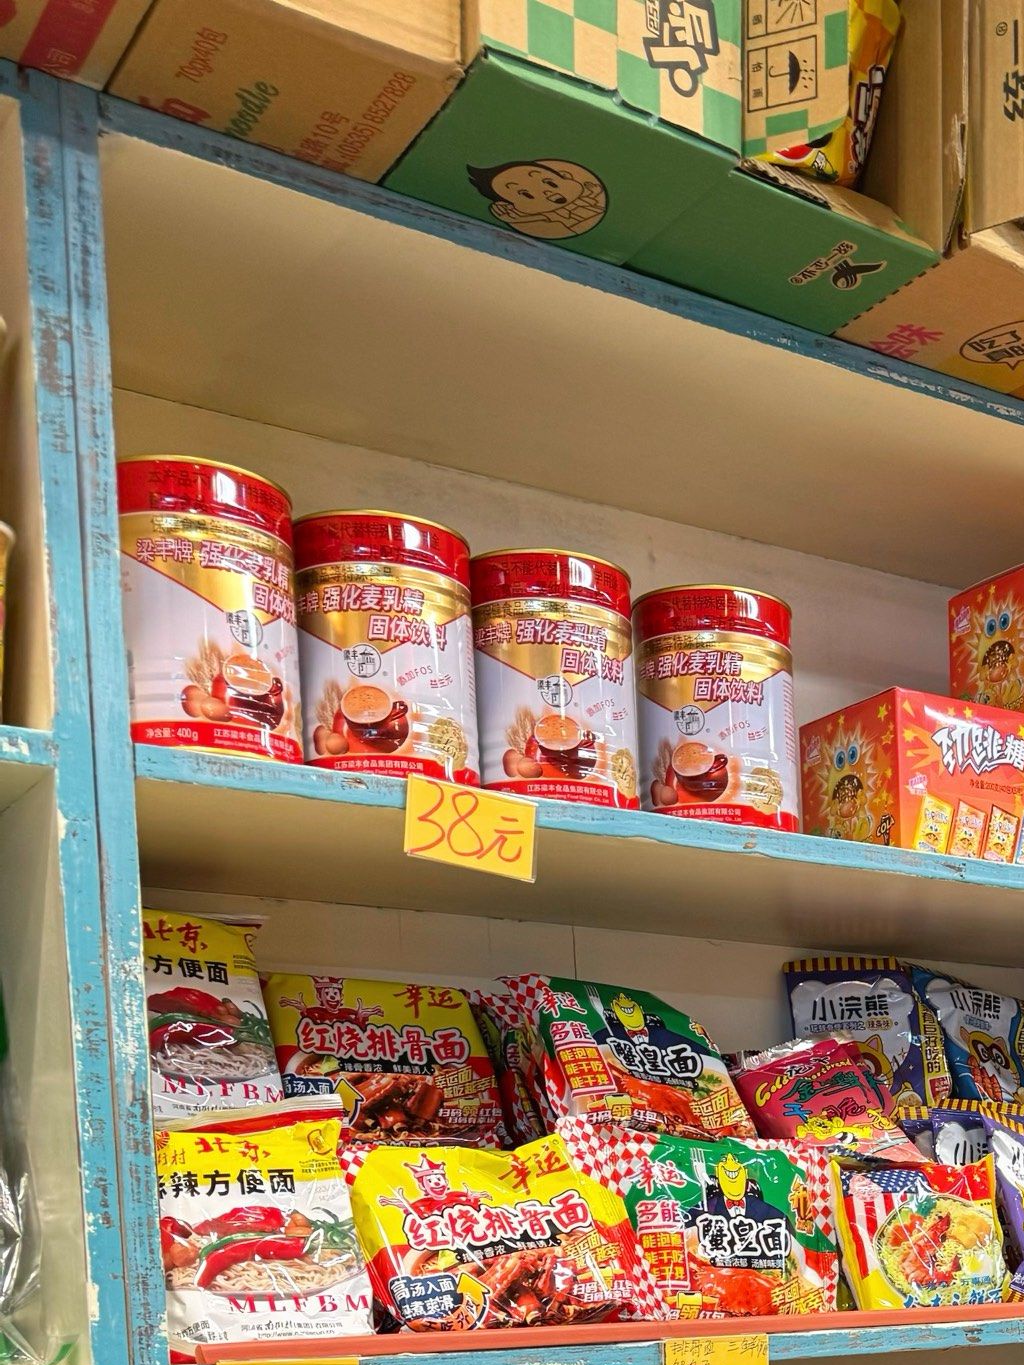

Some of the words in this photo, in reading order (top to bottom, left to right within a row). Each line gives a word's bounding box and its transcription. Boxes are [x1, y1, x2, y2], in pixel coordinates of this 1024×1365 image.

[322, 583, 425, 618] 强化麦乳精
[368, 615, 448, 652] 固体饮料
[516, 618, 608, 652] 强化麦乳精
[560, 648, 625, 686] 固体饮料
[657, 651, 744, 678] 强化麦乳精
[693, 676, 764, 705] 固体饮料
[418, 780, 524, 862] 38元
[148, 954, 229, 986] 方便面
[394, 983, 462, 1019] 幸运
[812, 994, 889, 1021] 小浣熊
[951, 990, 1002, 1020] 小浣熊
[300, 1020, 468, 1063] 红烧排骨面
[551, 1020, 593, 1041] 多能
[498, 1145, 569, 1196] 幸运
[407, 1191, 589, 1250] 红烧排骨面
[636, 1200, 681, 1224] 多能
[393, 1279, 455, 1300] 高汤入面
